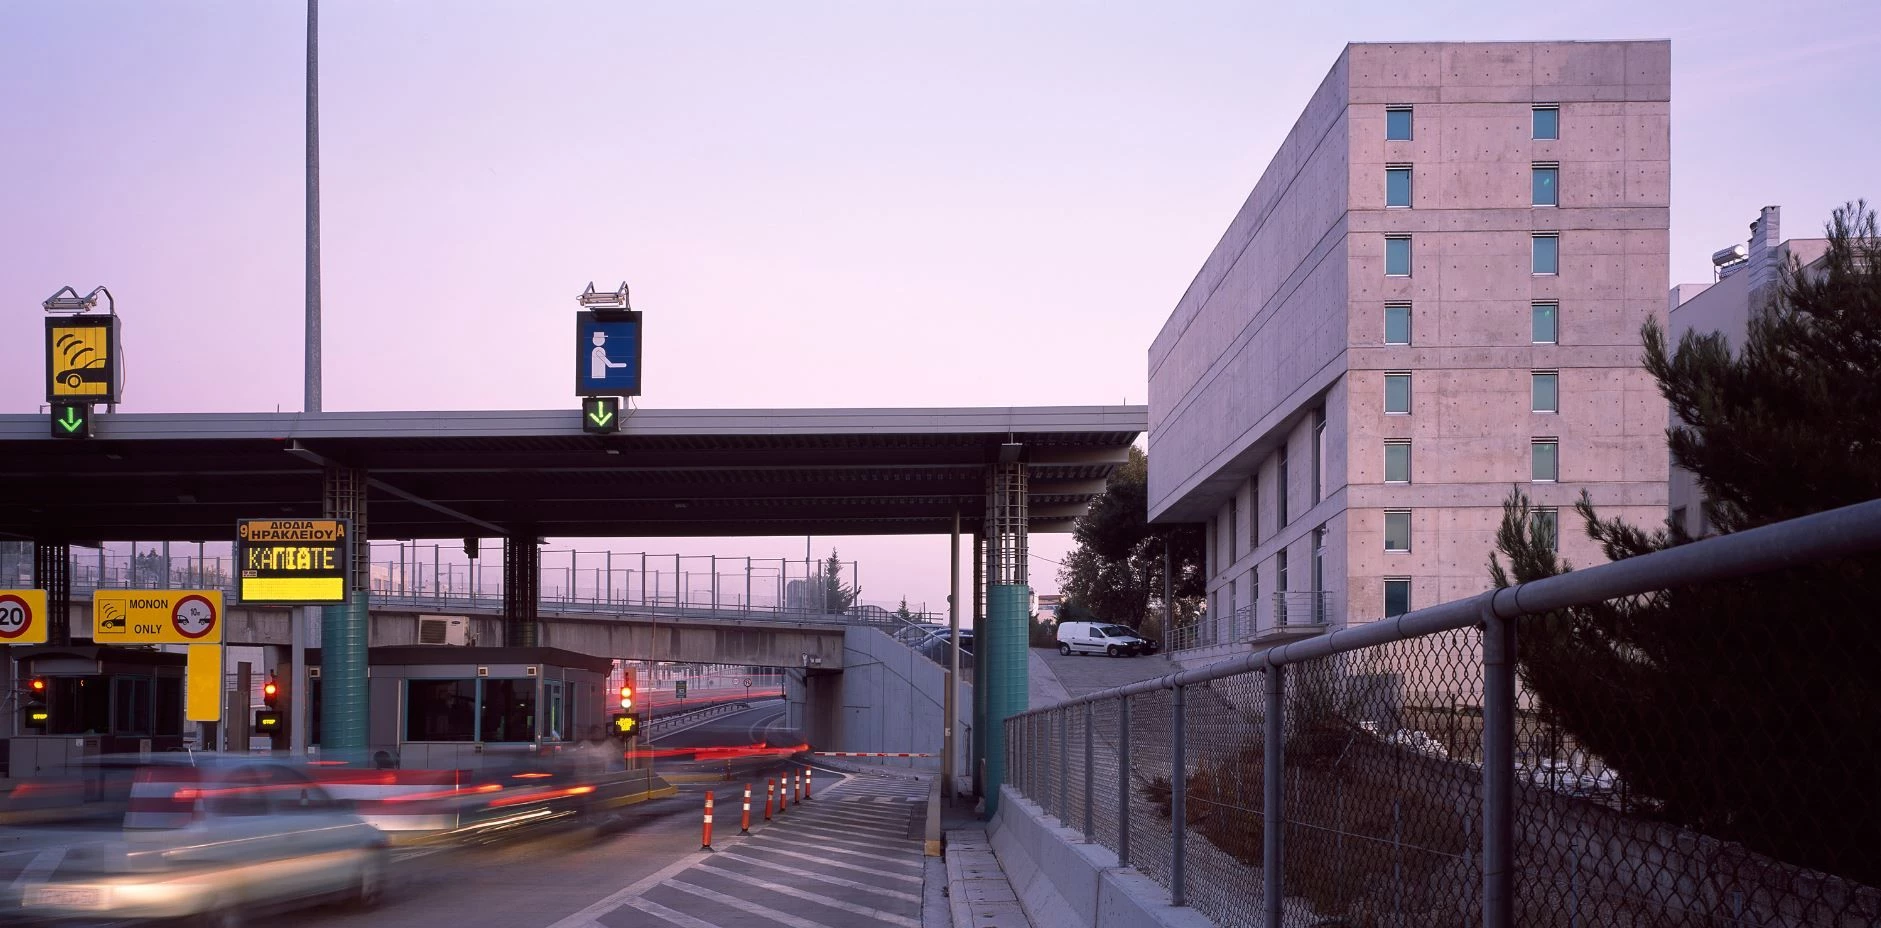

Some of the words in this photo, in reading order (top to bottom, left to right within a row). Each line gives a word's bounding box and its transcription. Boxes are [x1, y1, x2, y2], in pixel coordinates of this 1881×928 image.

[270, 521, 314, 530] ΔΙΟΔΙΑ
[240, 524, 248, 538] 9
[251, 530, 334, 540] ΗΡΑΚΛΕΙΟΥ
[0, 607, 24, 626] 20
[134, 624, 162, 634] ONLY
